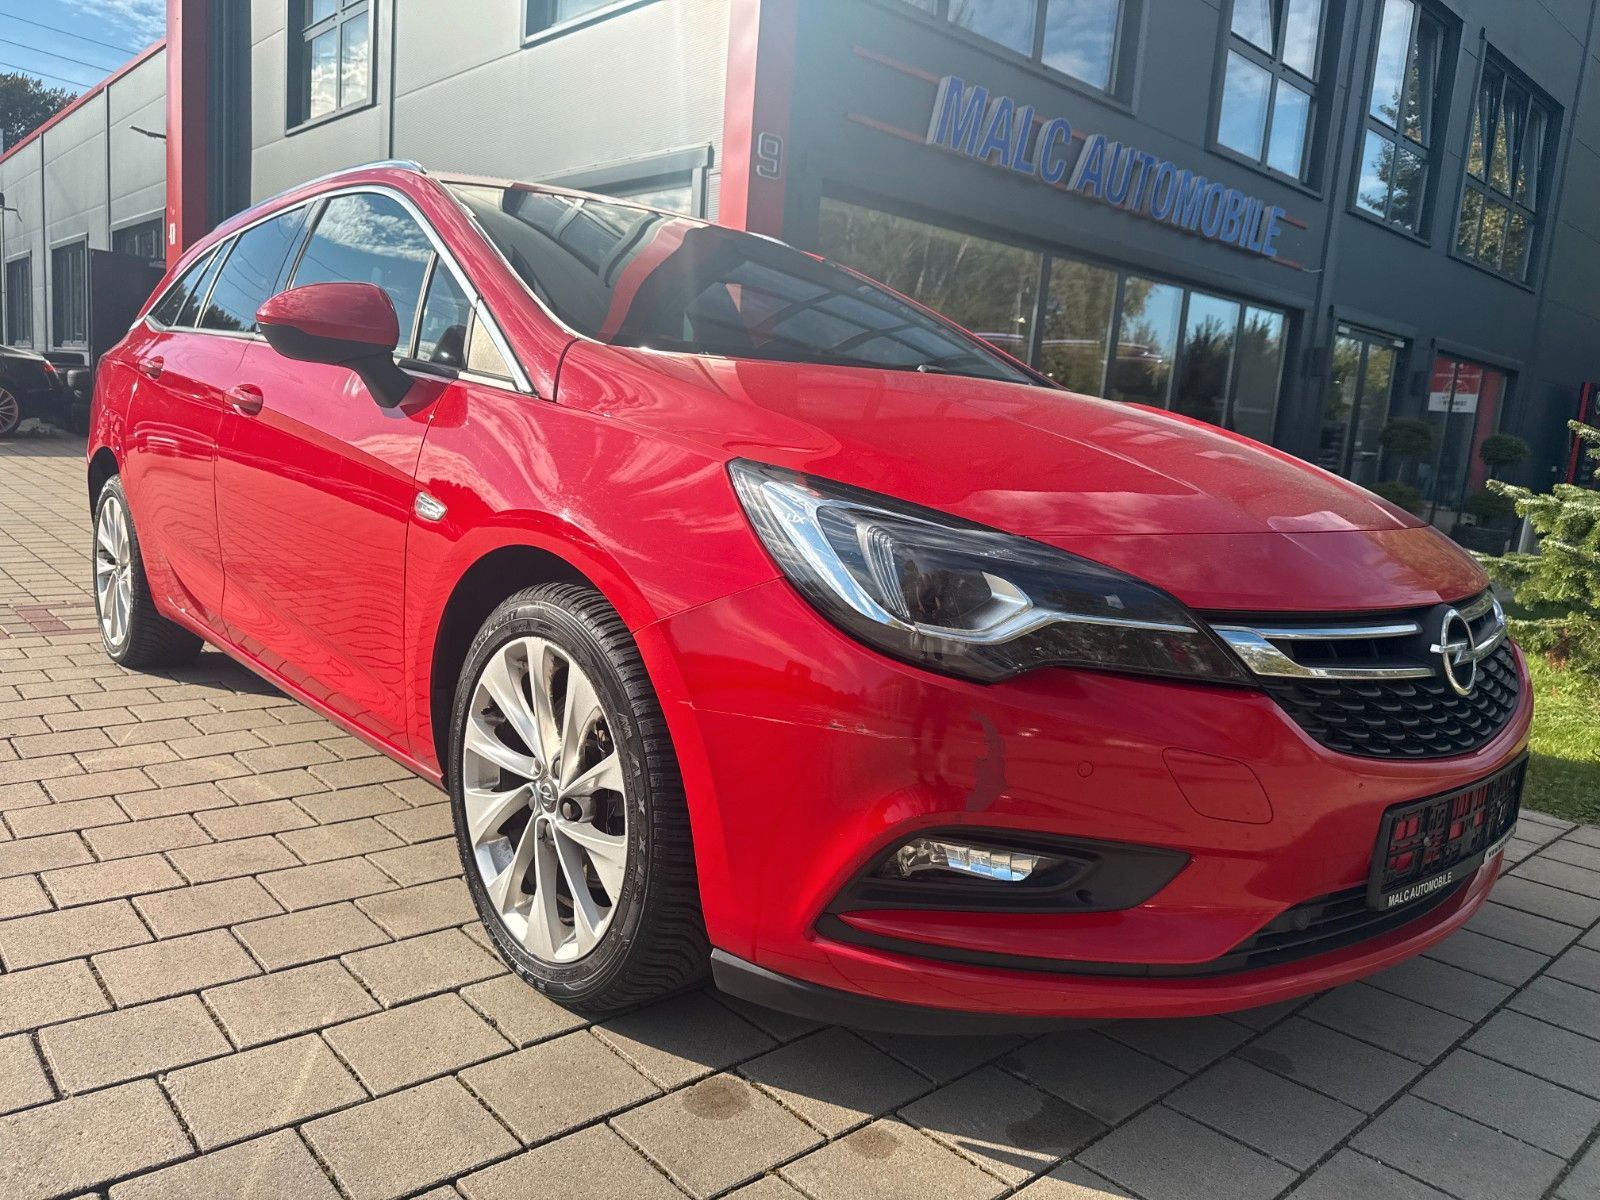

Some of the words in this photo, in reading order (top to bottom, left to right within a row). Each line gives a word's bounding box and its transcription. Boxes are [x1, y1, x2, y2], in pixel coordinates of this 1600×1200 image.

[756, 132, 784, 180] 9
[931, 75, 1073, 184] MALC
[1068, 134, 1286, 257] AUTOMOBILE
[1388, 889, 1410, 907] MALC
[1410, 871, 1452, 899] AUTOMOBILE
